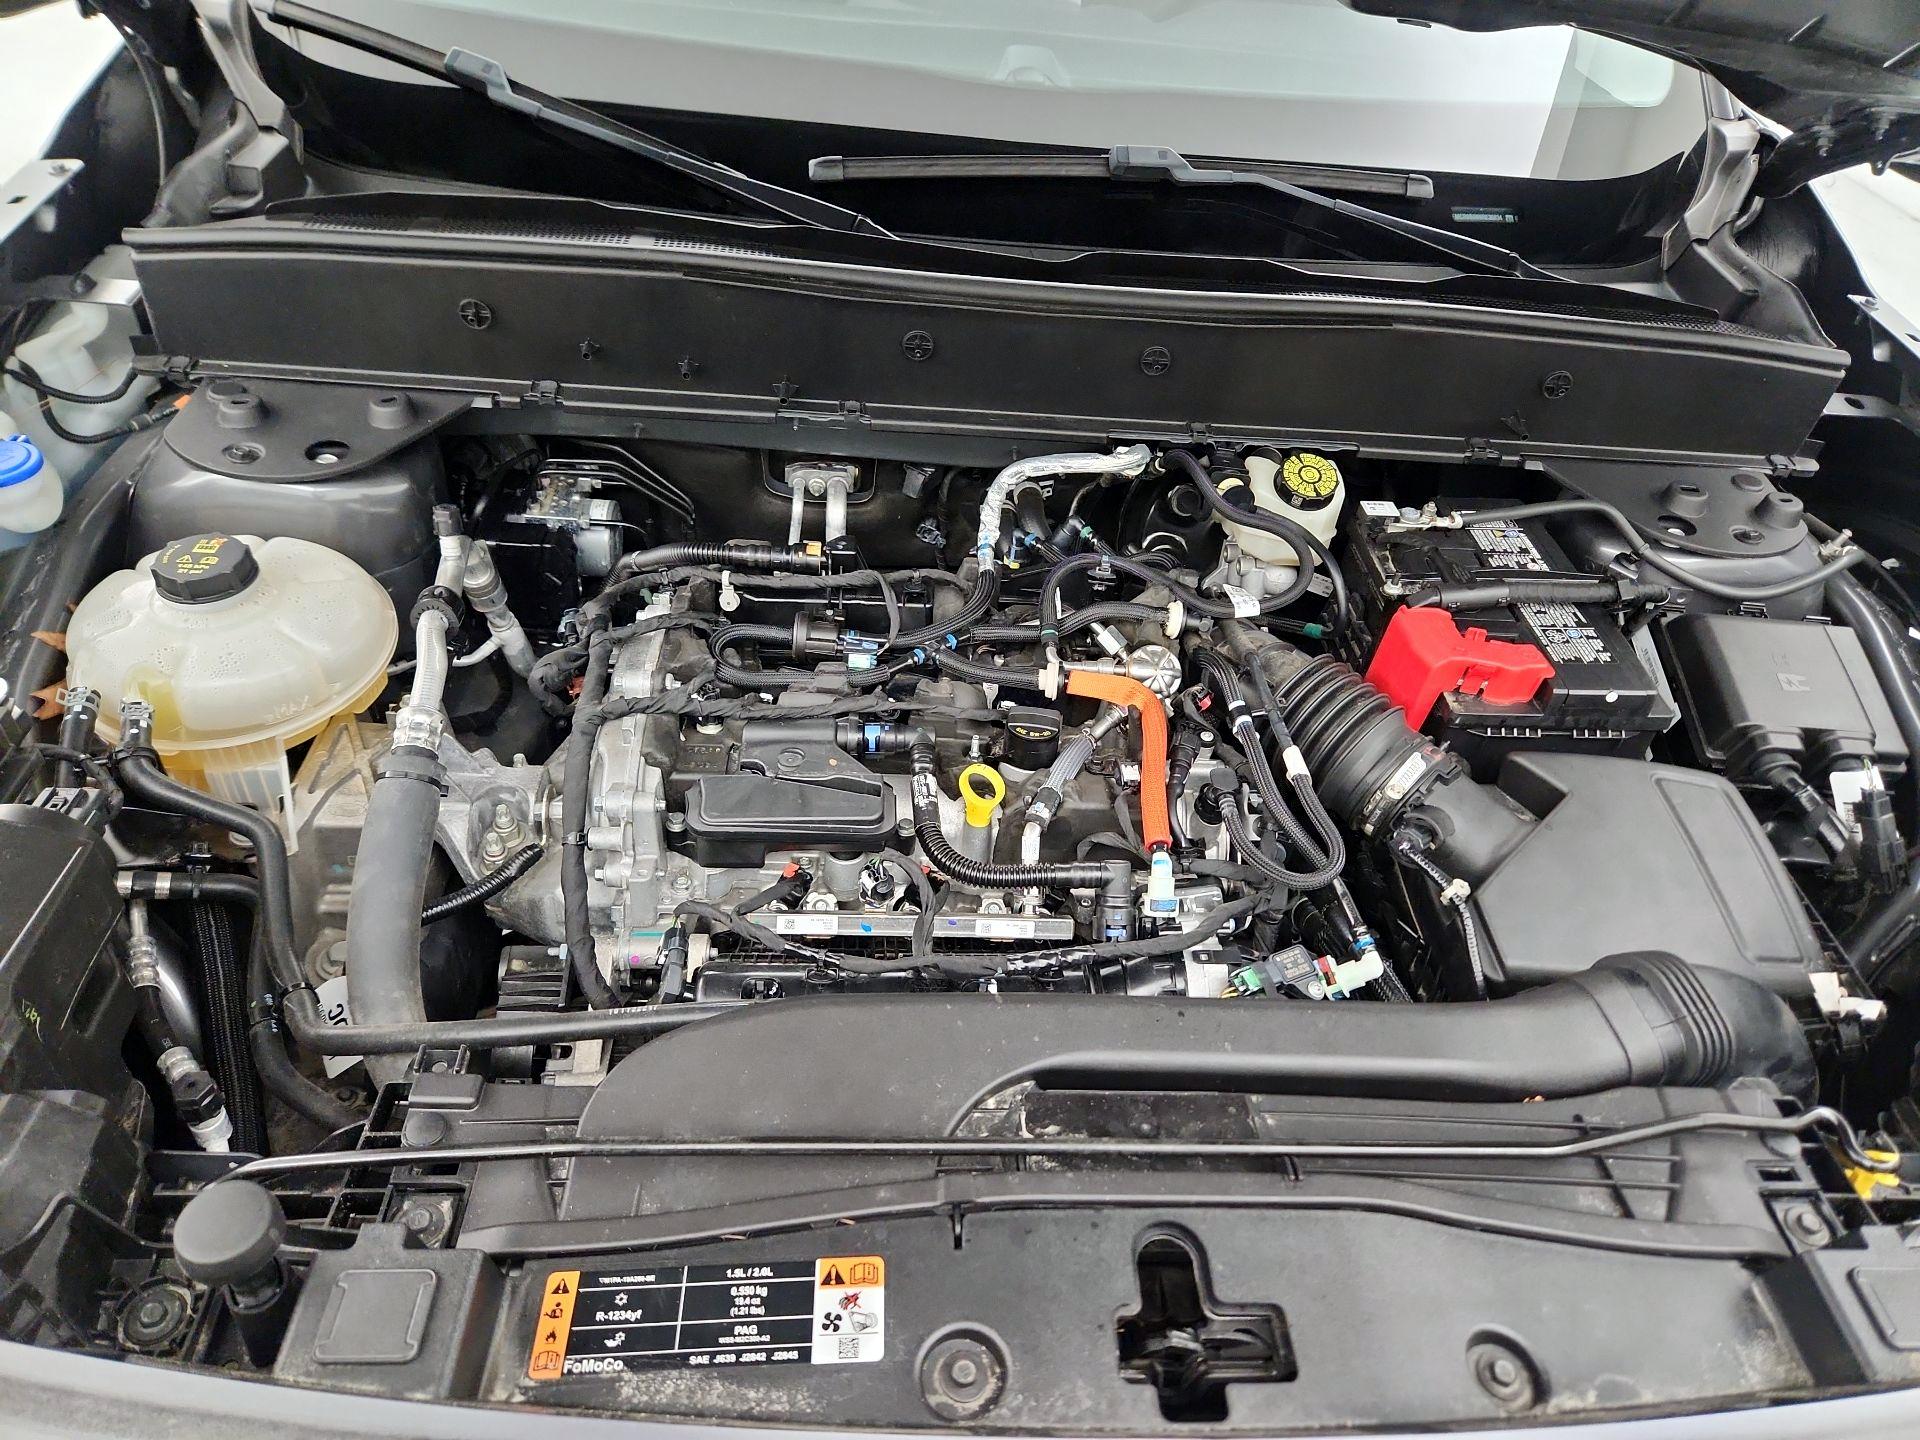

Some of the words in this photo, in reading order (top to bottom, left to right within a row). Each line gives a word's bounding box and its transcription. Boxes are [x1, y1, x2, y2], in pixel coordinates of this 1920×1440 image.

[726, 1268, 746, 1279] 1.5L
[755, 1285, 768, 1297] kg
[595, 1309, 643, 1322] R-1234yf
[733, 1324, 758, 1336] PAG
[563, 1358, 624, 1374] FoMoCo
[689, 1355, 710, 1365] SAE
